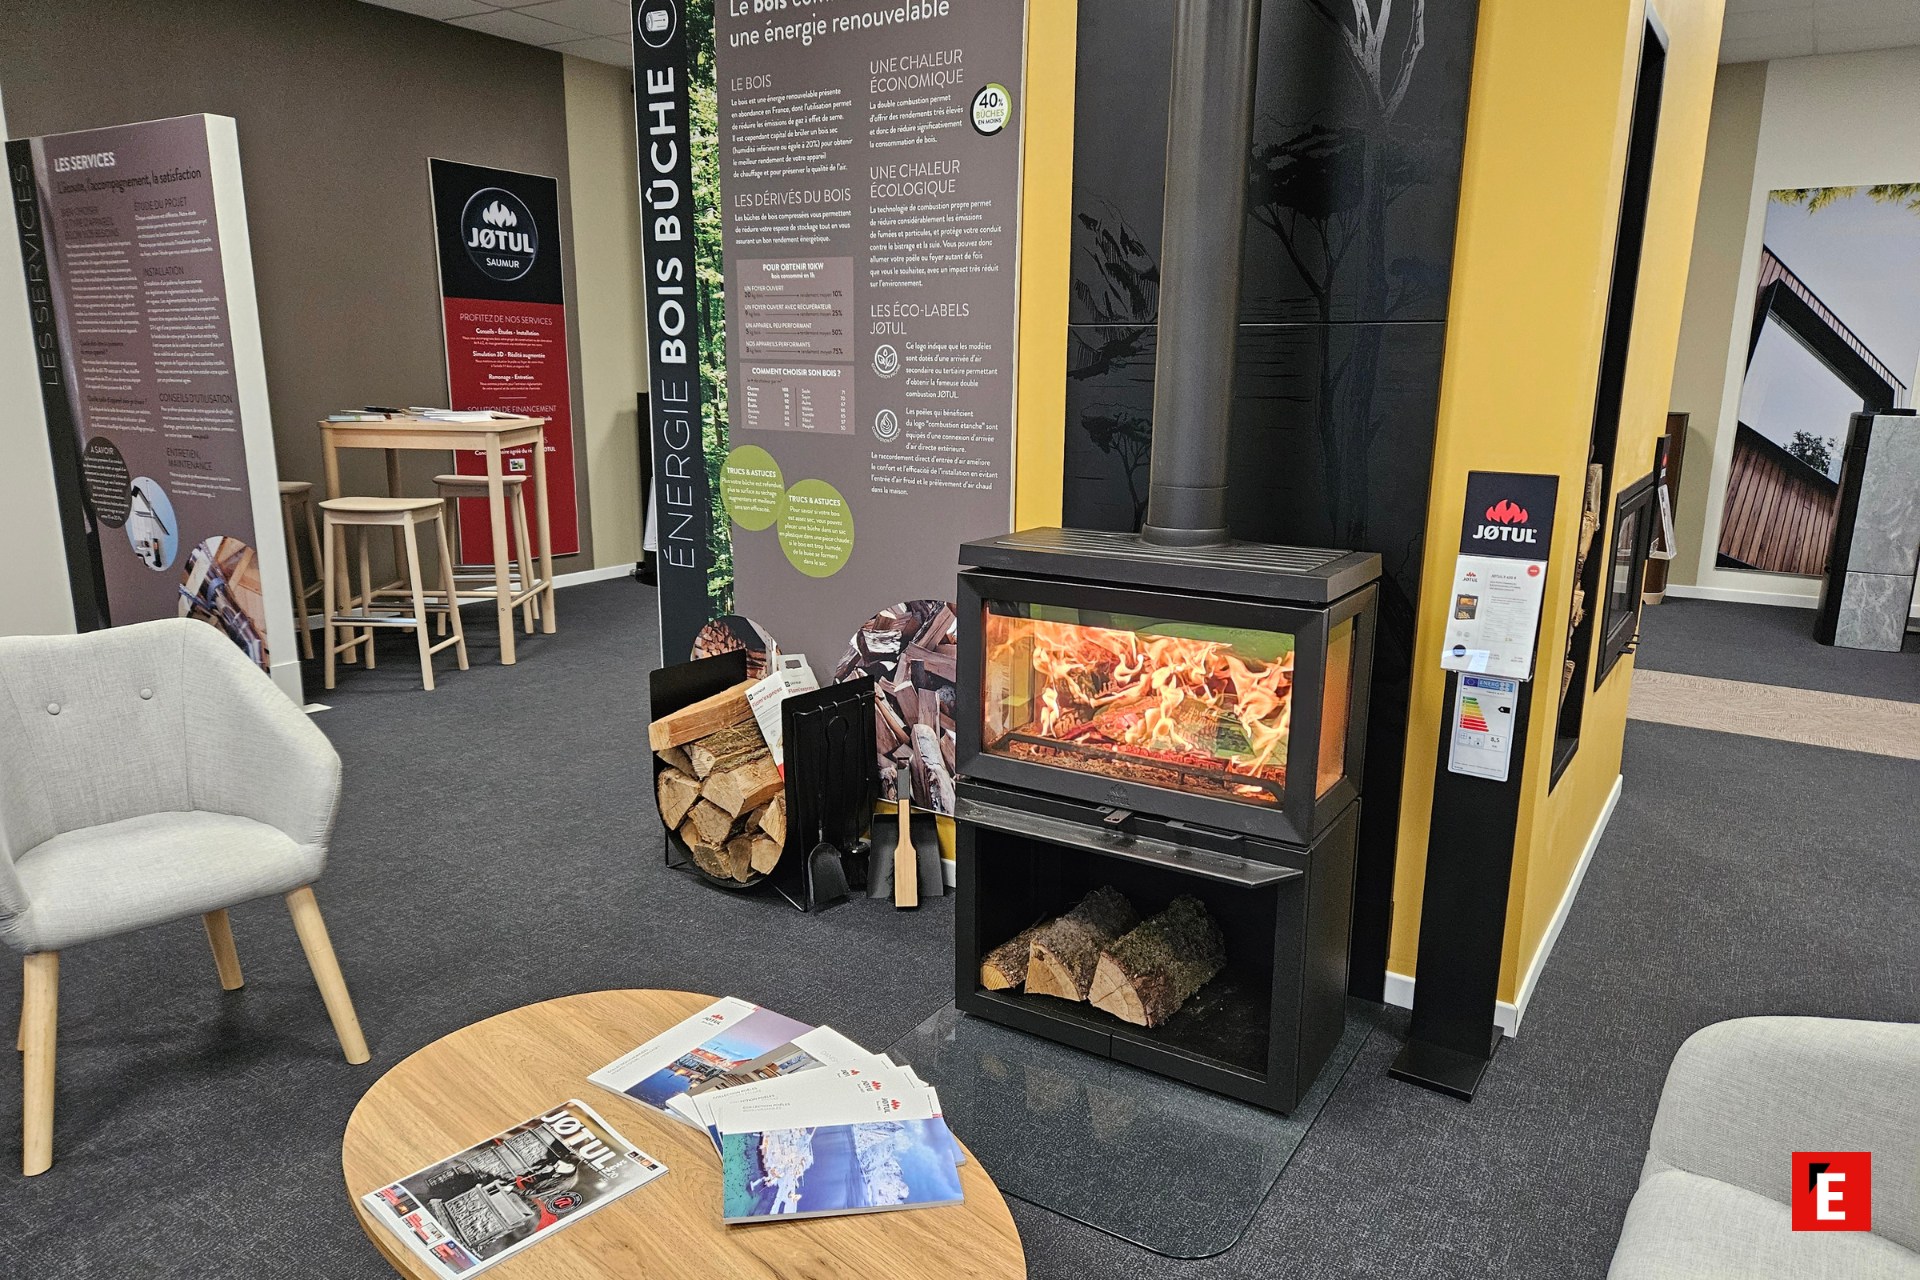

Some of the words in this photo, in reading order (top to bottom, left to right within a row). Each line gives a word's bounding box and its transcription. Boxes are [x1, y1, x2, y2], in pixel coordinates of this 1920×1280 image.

[730, 0, 748, 17] Le
[754, 0, 787, 14] bois
[730, 27, 759, 48] une
[764, 13, 826, 46] énergie
[832, 0, 949, 32] renouvelable
[870, 58, 897, 74] UNE
[900, 49, 963, 71] CHALEUR
[731, 78, 742, 91] LE
[746, 74, 771, 89] BOIS
[870, 69, 964, 93] ÉCONOMIQUE
[767, 94, 785, 103] énergie
[786, 90, 818, 100] renouvelable
[819, 89, 841, 99] présente
[877, 100, 895, 108] double
[897, 98, 929, 106] combustion
[930, 94, 951, 105] permet
[738, 110, 764, 118] abondance
[772, 106, 790, 114] France,
[804, 102, 831, 111] l'utilisation
[833, 100, 851, 110] permet
[976, 109, 1004, 119] BÛCHES
[890, 126, 896, 134] de
[917, 120, 962, 133] significativement
[875, 139, 914, 148] consommation
[916, 136, 922, 144] de
[924, 135, 937, 143] bois.
[54, 158, 70, 172] LES
[71, 152, 115, 170] SERVICES
[645, 67, 682, 242] BÛCHE
[152, 171, 159, 184] la
[160, 166, 201, 183] satisfaction
[870, 165, 896, 180] UNE
[899, 160, 960, 177] CHALEUR
[870, 179, 956, 198] ÉCOLOGIQUE
[734, 194, 752, 207] LES
[755, 189, 801, 206] DÉRIVÉS
[804, 190, 821, 203] DU
[824, 188, 851, 202] BOIS
[15, 164, 49, 324] SERVICES
[468, 227, 534, 253] JØTUL
[144, 266, 184, 276] INSTALLATION
[486, 258, 520, 268] SAUMUR
[781, 263, 807, 271] OBTENIR
[656, 257, 687, 364] BOIS
[871, 304, 890, 317] LES
[894, 301, 970, 317] ÉCO-LABELS
[460, 313, 493, 322] PROFITEZ
[495, 315, 504, 323] DE
[521, 317, 552, 326] SERVICES
[870, 322, 907, 334] JØTUL
[915, 342, 926, 352] logo
[928, 342, 947, 352] indique
[969, 342, 991, 350] modèles
[39, 332, 59, 386] LES
[782, 368, 807, 376] CHOISIR
[159, 394, 189, 403] CONSEILS
[168, 460, 212, 471] MAINTENANCE
[661, 380, 695, 568] ÉNERGIE
[727, 467, 745, 475] TRUCS
[751, 470, 776, 478] ASTUCES
[789, 495, 808, 503] TRUCS
[809, 496, 813, 504] &
[814, 497, 840, 506] ASTUCES
[1473, 525, 1536, 544] JØTUL
[541, 1110, 616, 1170] JØTUL
[602, 1159, 628, 1173] News
